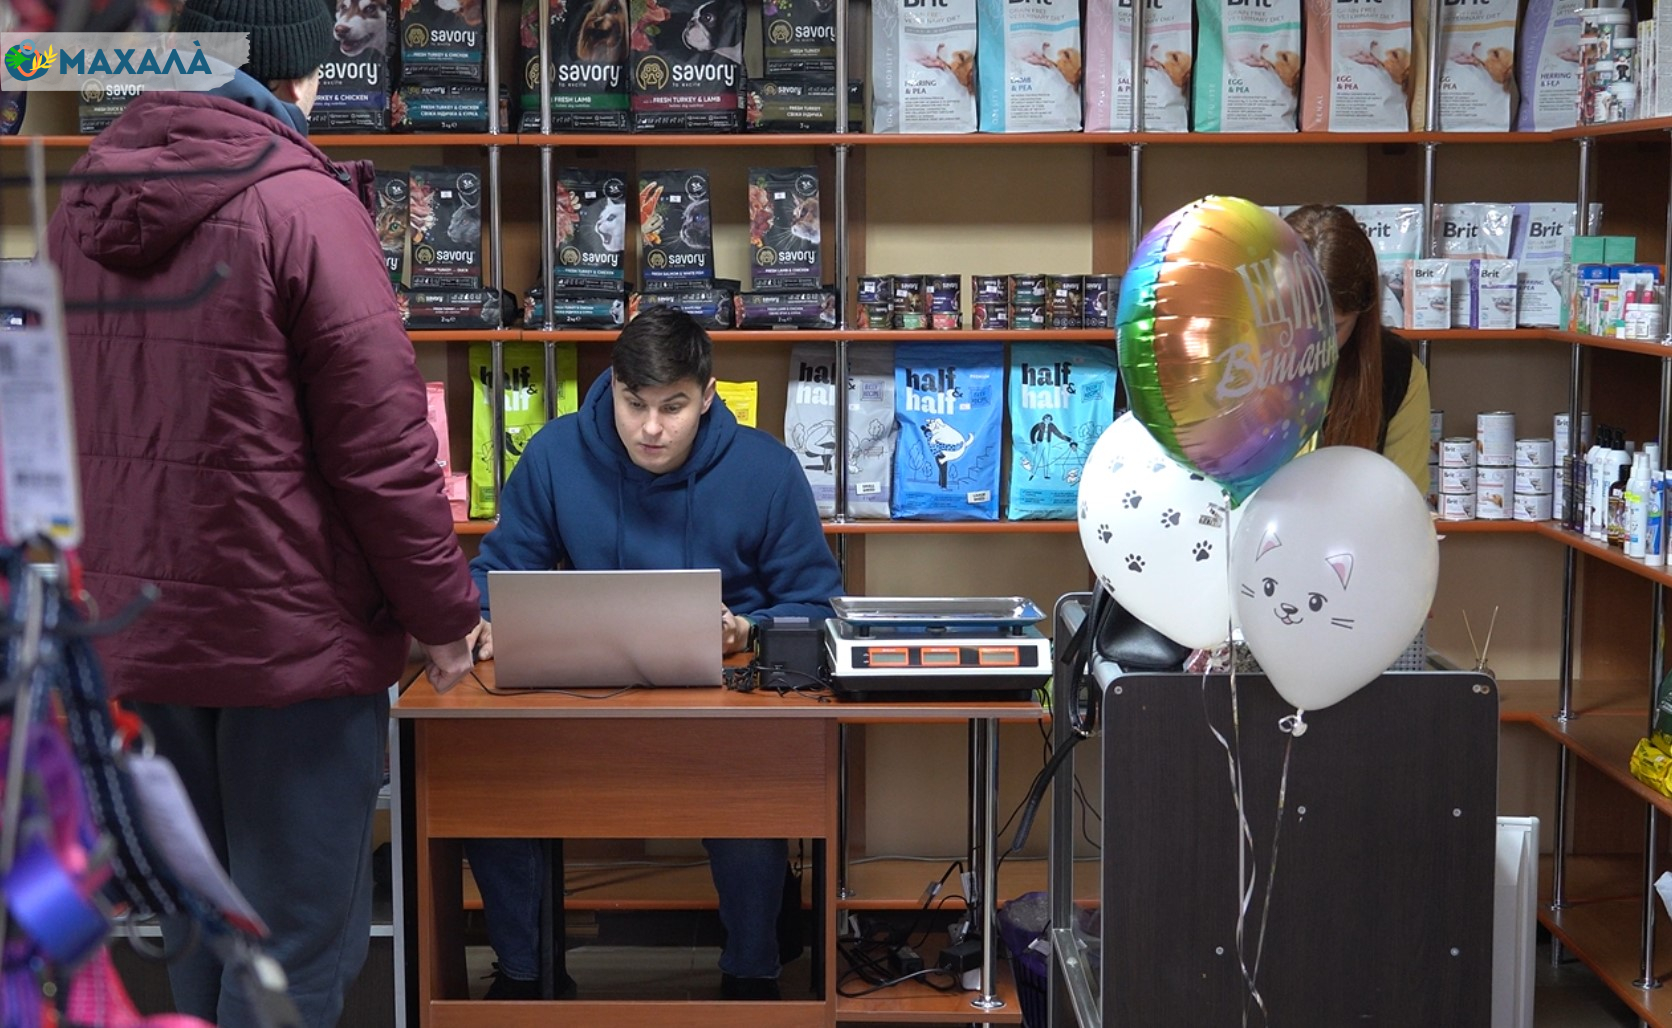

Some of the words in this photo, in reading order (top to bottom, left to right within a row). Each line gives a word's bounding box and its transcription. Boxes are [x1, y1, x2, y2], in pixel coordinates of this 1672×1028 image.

[431, 29, 475, 47] savory
[795, 25, 835, 41] savory
[318, 62, 378, 85] savory
[558, 64, 620, 87] savory
[672, 64, 735, 87] savory
[106, 84, 145, 96] savor
[778, 86, 802, 95] savory
[1443, 221, 1478, 238] Brit
[1529, 221, 1563, 237] Brit
[436, 251, 474, 264] savory
[582, 252, 618, 267] savory
[668, 253, 706, 267] savory
[778, 250, 815, 264] savory
[1415, 269, 1434, 278] Brit
[1481, 269, 1499, 278] Brit
[906, 366, 956, 392] half
[1022, 361, 1072, 387] half
[527, 384, 538, 395] &
[796, 382, 836, 406] hal
[952, 387, 963, 397] &
[1066, 382, 1076, 394] &
[906, 387, 956, 415] half
[1022, 384, 1070, 410] half
